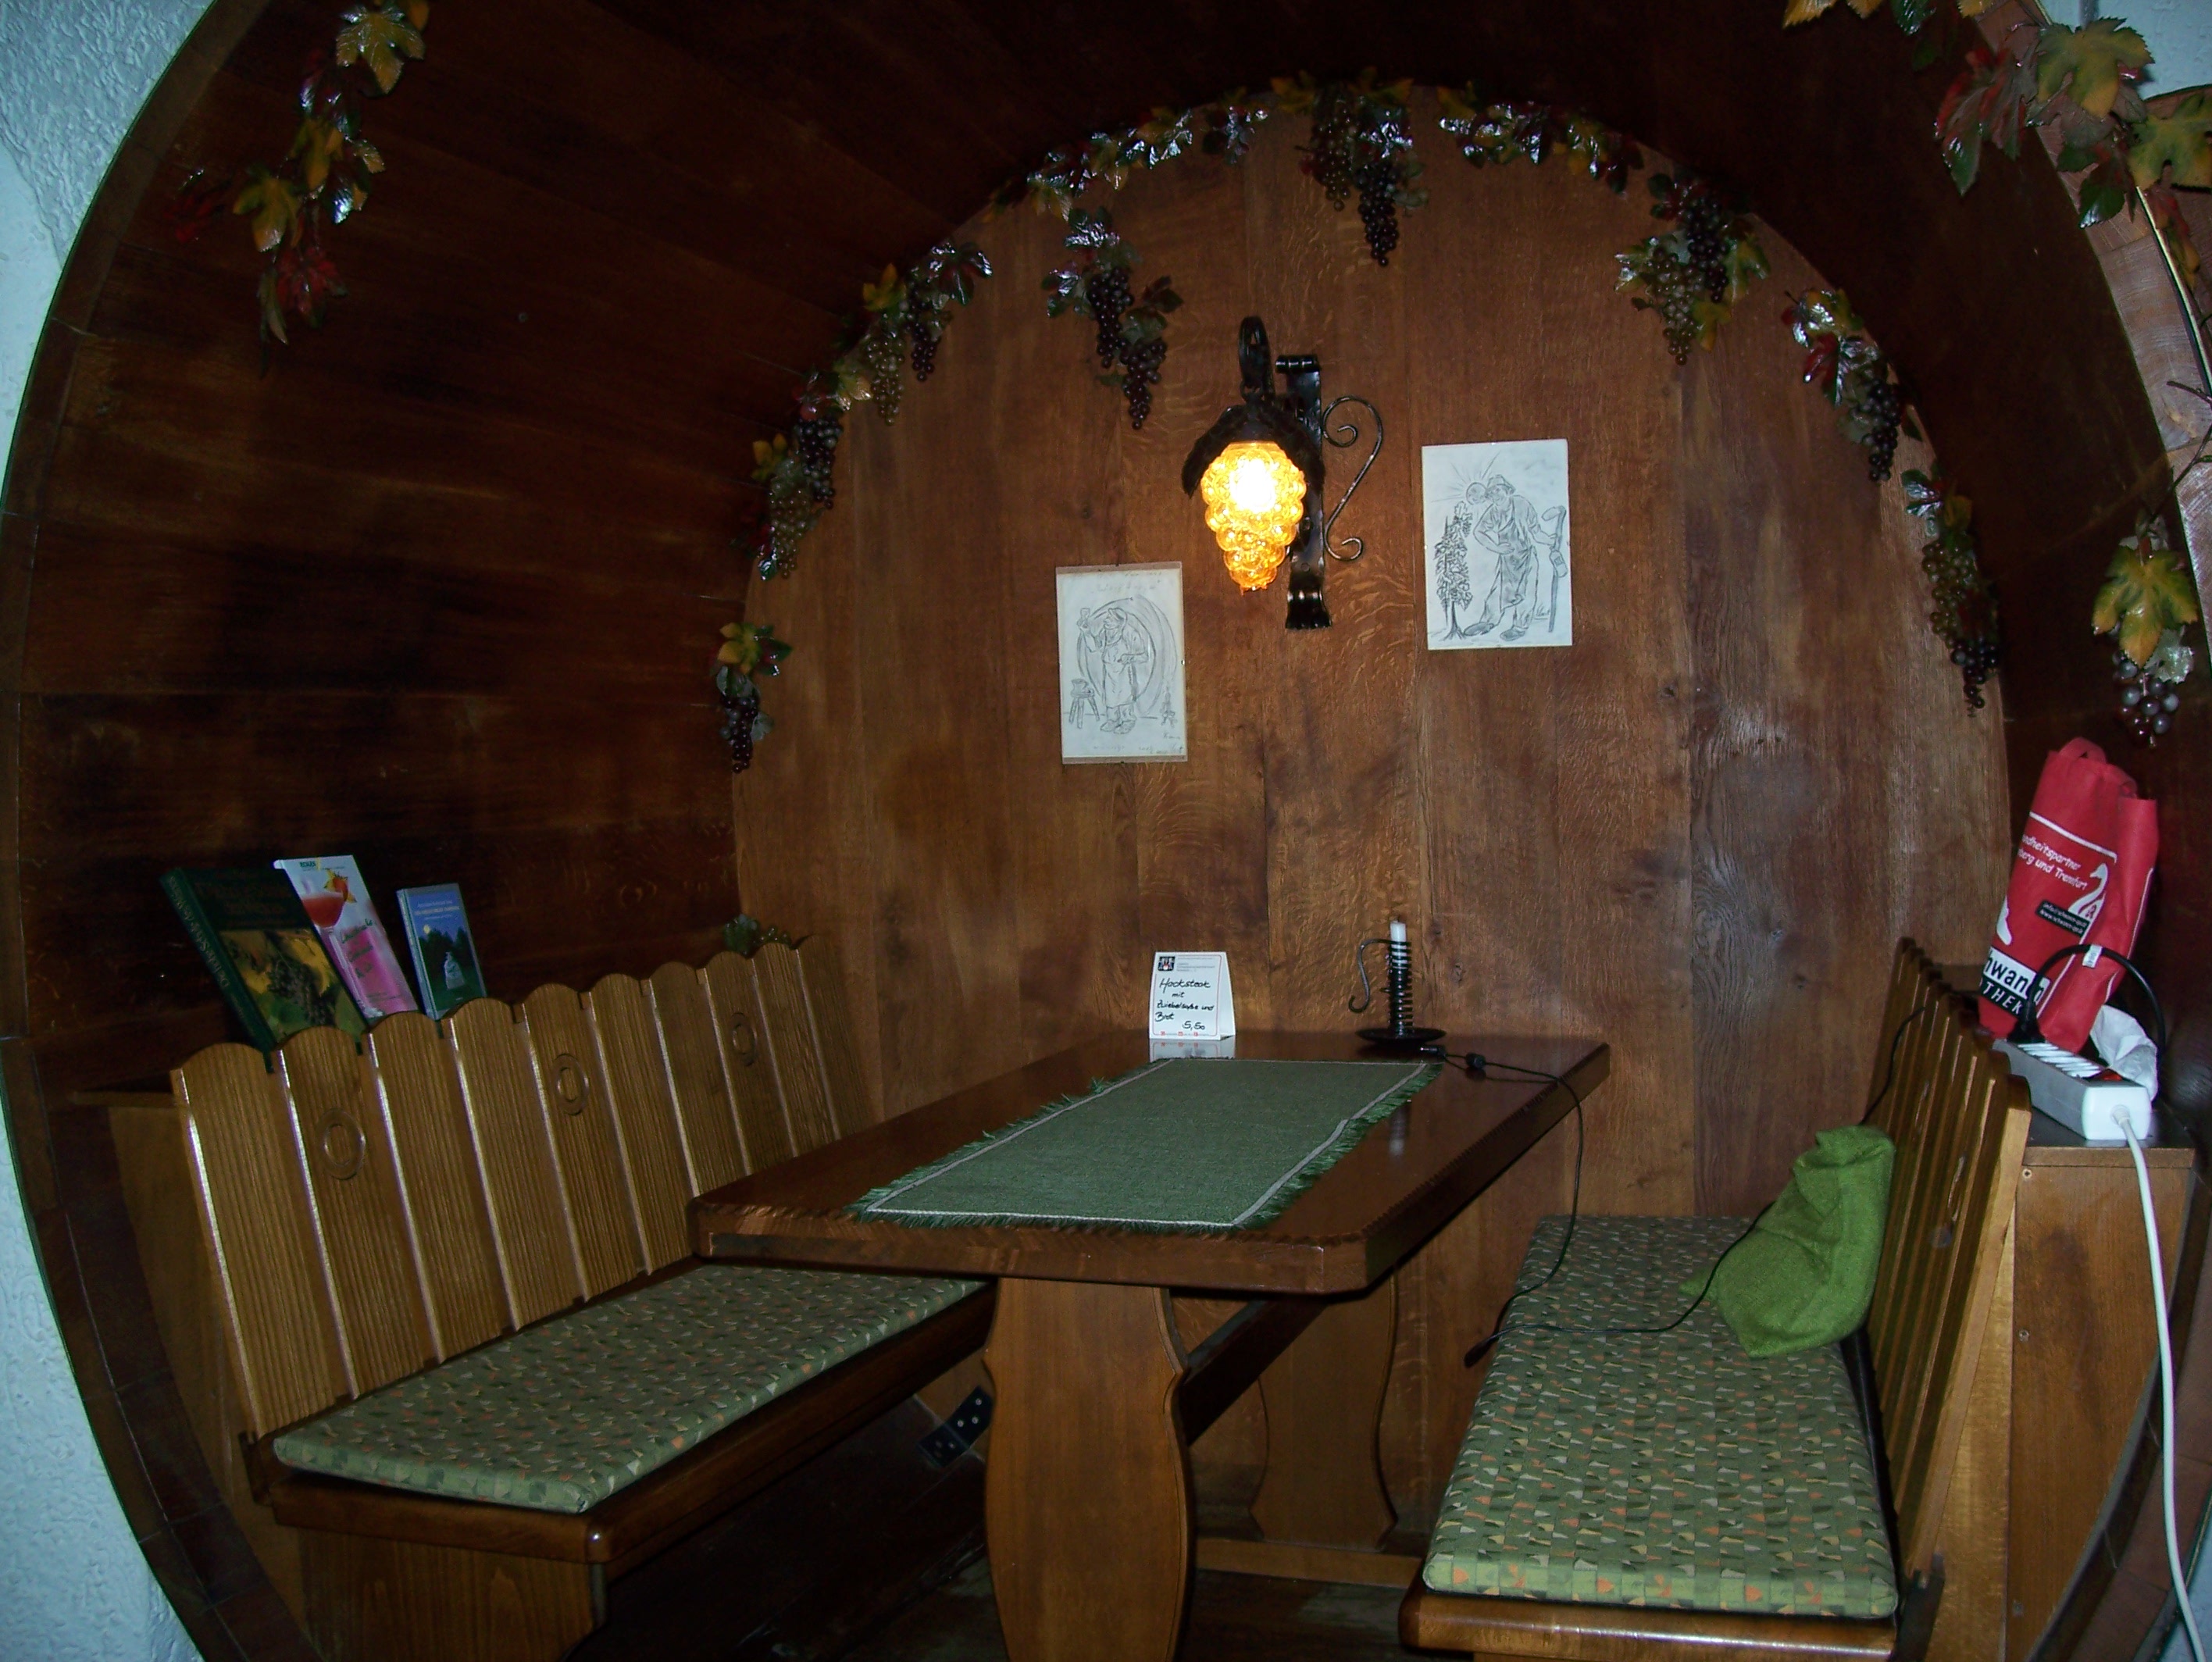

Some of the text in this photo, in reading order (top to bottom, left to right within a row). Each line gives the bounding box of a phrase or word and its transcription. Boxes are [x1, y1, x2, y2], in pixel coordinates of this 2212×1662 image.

[2035, 859, 2055, 873] und
[1979, 977, 2024, 1015] THEK
[1154, 1011, 1175, 1022] Brot
[1182, 1020, 1205, 1031] 5,50
